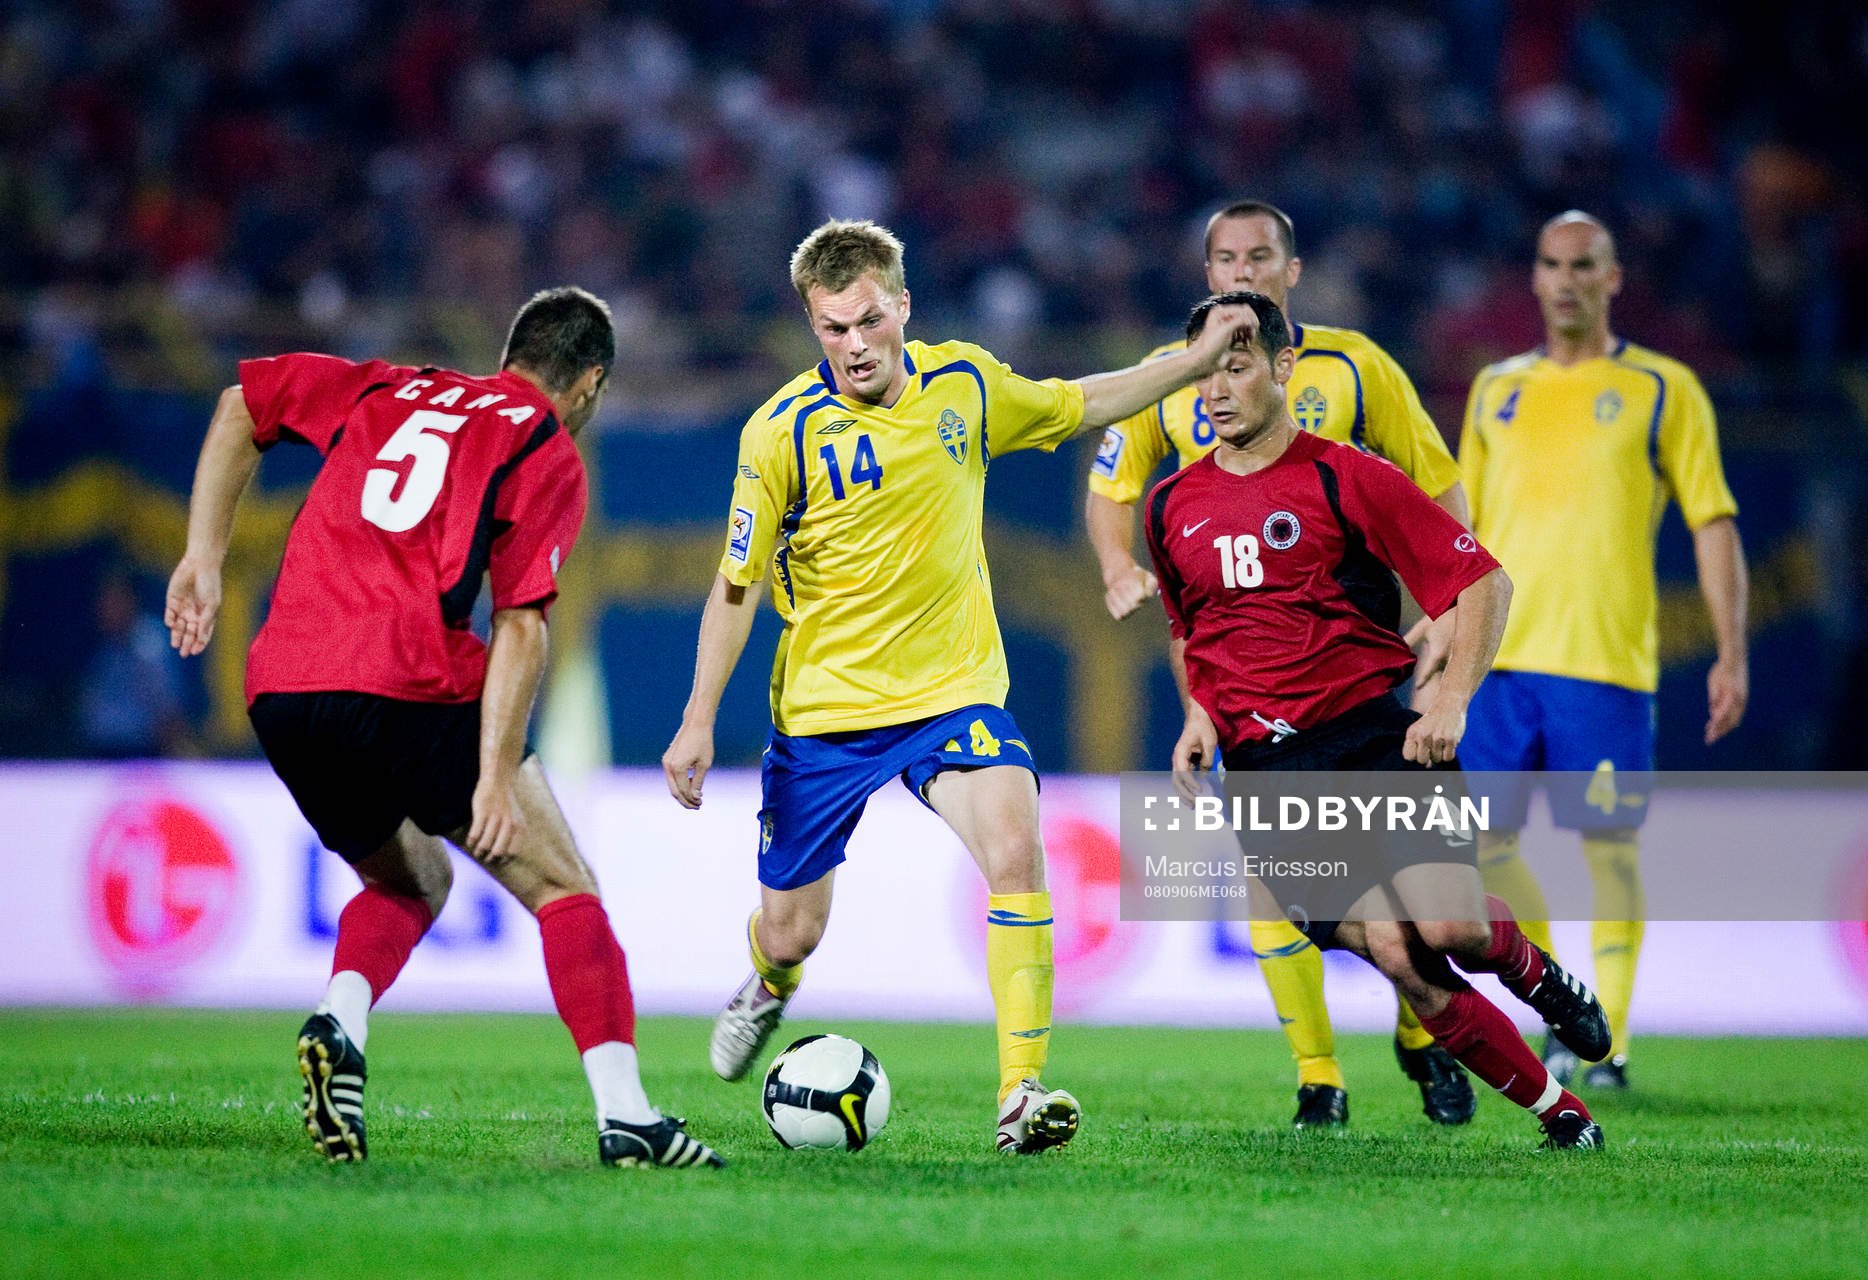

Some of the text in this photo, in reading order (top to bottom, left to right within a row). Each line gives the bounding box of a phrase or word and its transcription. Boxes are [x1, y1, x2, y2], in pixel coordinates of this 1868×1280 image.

[394, 379, 537, 425] CANA
[1192, 396, 1217, 446] 8
[361, 409, 468, 533] 5
[819, 433, 884, 501] 14
[1212, 534, 1265, 590] 18
[1584, 758, 1618, 816] 4
